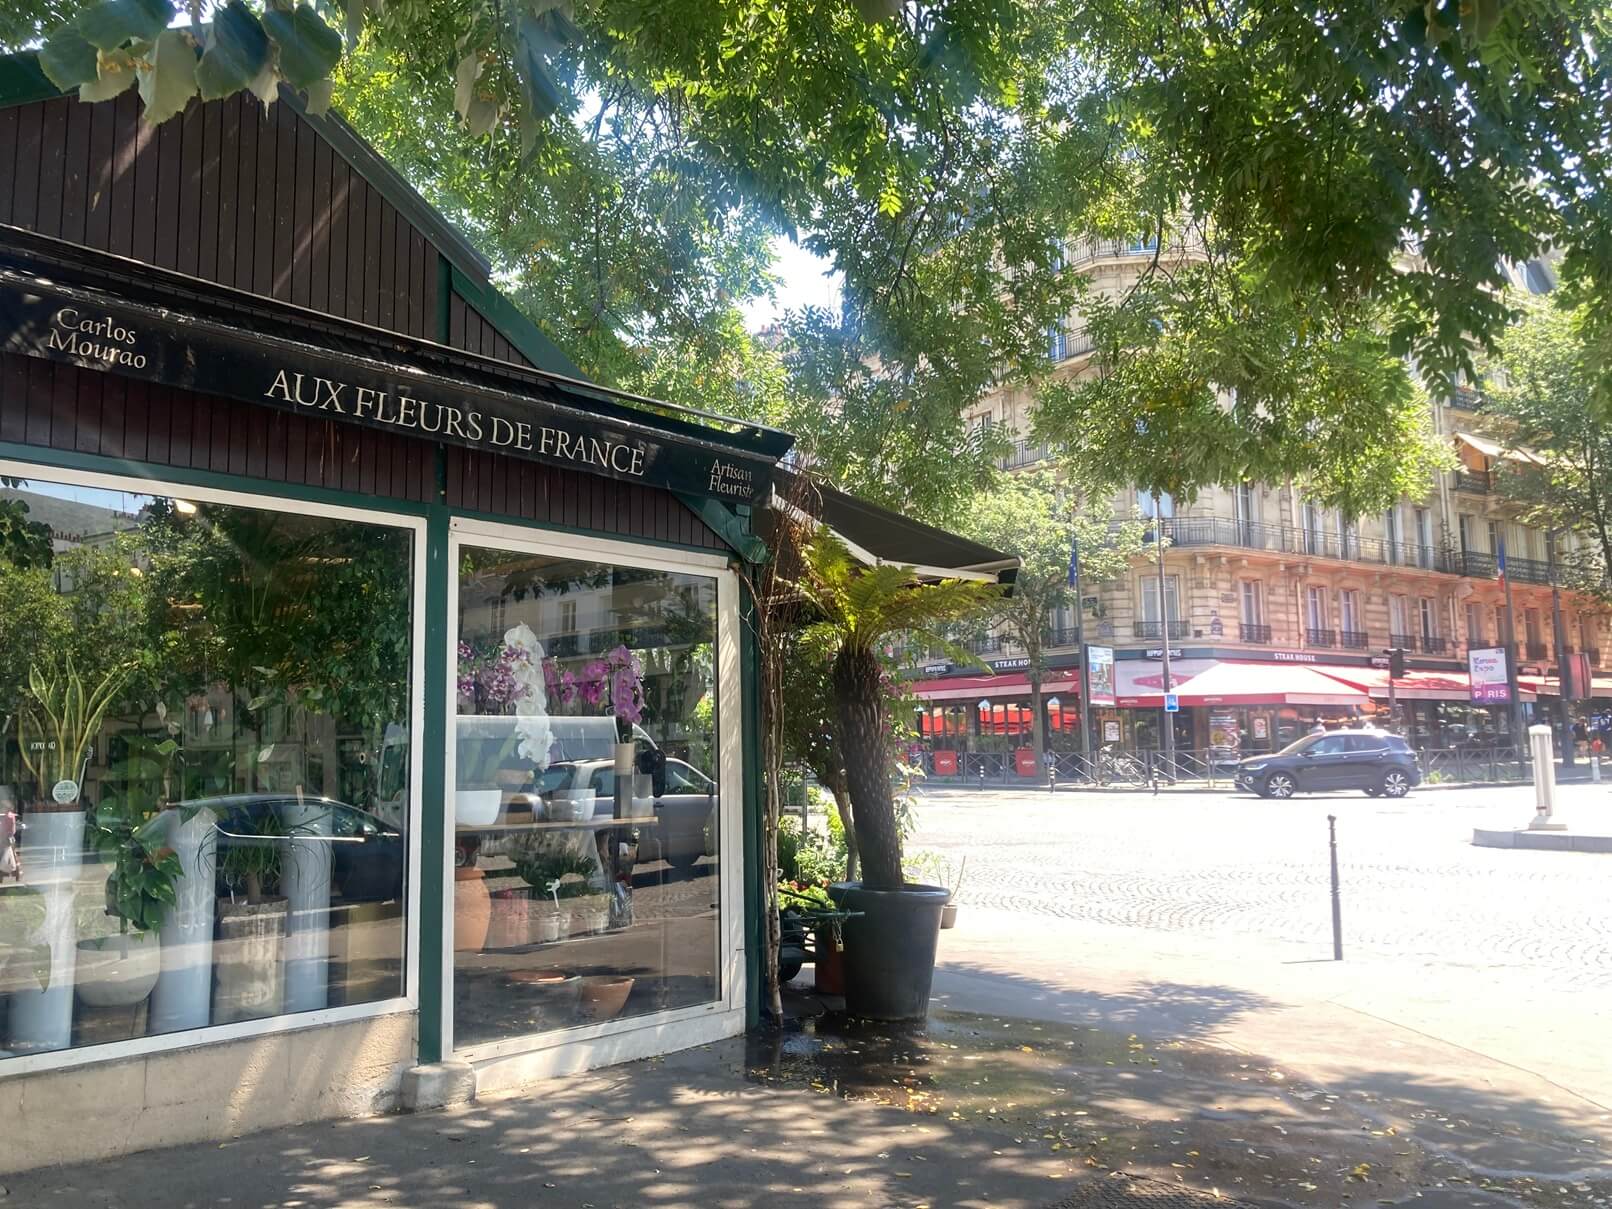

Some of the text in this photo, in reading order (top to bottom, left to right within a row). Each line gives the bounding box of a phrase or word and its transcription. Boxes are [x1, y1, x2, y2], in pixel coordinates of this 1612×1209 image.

[56, 308, 137, 345] Carlos
[47, 328, 147, 370] Mourao
[264, 369, 645, 477] AUX FLEURS DE FRANCE
[709, 458, 752, 482] Artisan
[995, 660, 1017, 668] STEAK
[1274, 652, 1316, 662] STEAK HOUSE
